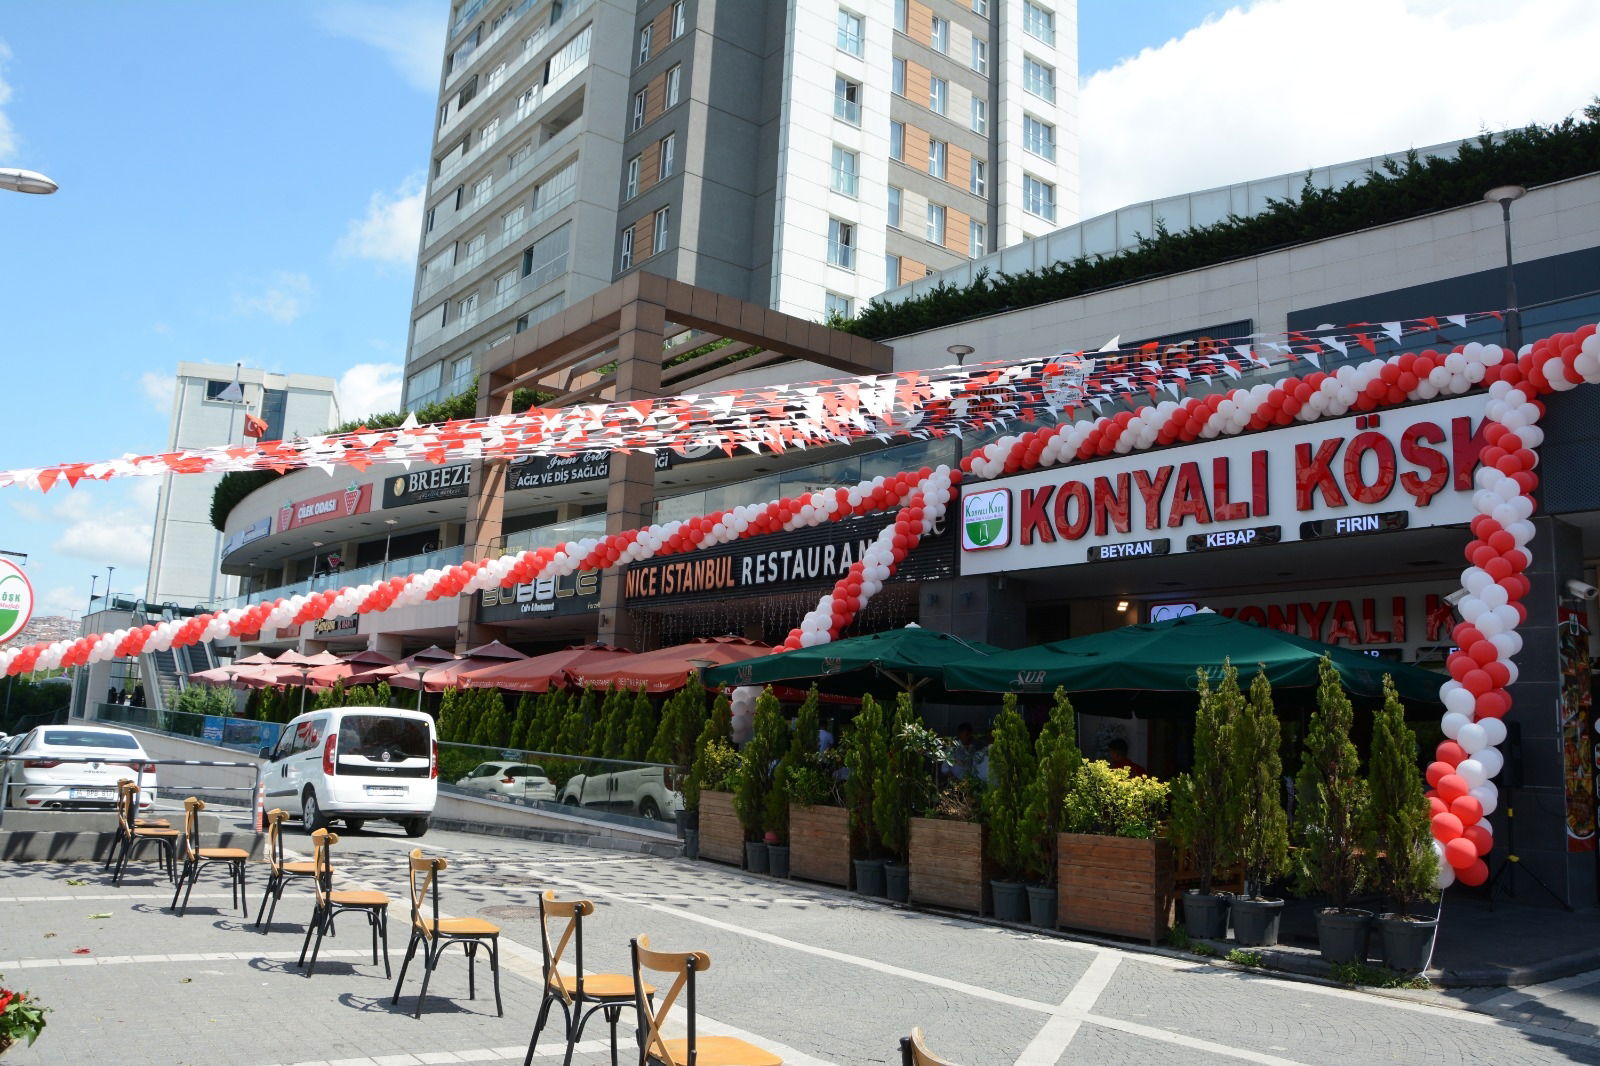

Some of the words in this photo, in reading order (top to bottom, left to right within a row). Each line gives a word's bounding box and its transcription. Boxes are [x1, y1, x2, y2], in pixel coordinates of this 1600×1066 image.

[408, 464, 472, 492] BREEZE
[541, 473, 553, 483] VE
[555, 469, 569, 483] DİŞ
[1020, 450, 1271, 545] KONYALI
[1296, 414, 1494, 507] KÖŞK
[1336, 515, 1379, 533] FIRIN
[1206, 530, 1256, 547] KEBAP
[1101, 541, 1153, 558] BEYRAN
[625, 567, 656, 598] NICE
[660, 556, 735, 594] ISTANBUL
[741, 538, 874, 585] RESTAURAN
[1212, 596, 1405, 645] NYALI
[1018, 670, 1046, 683] SUR
